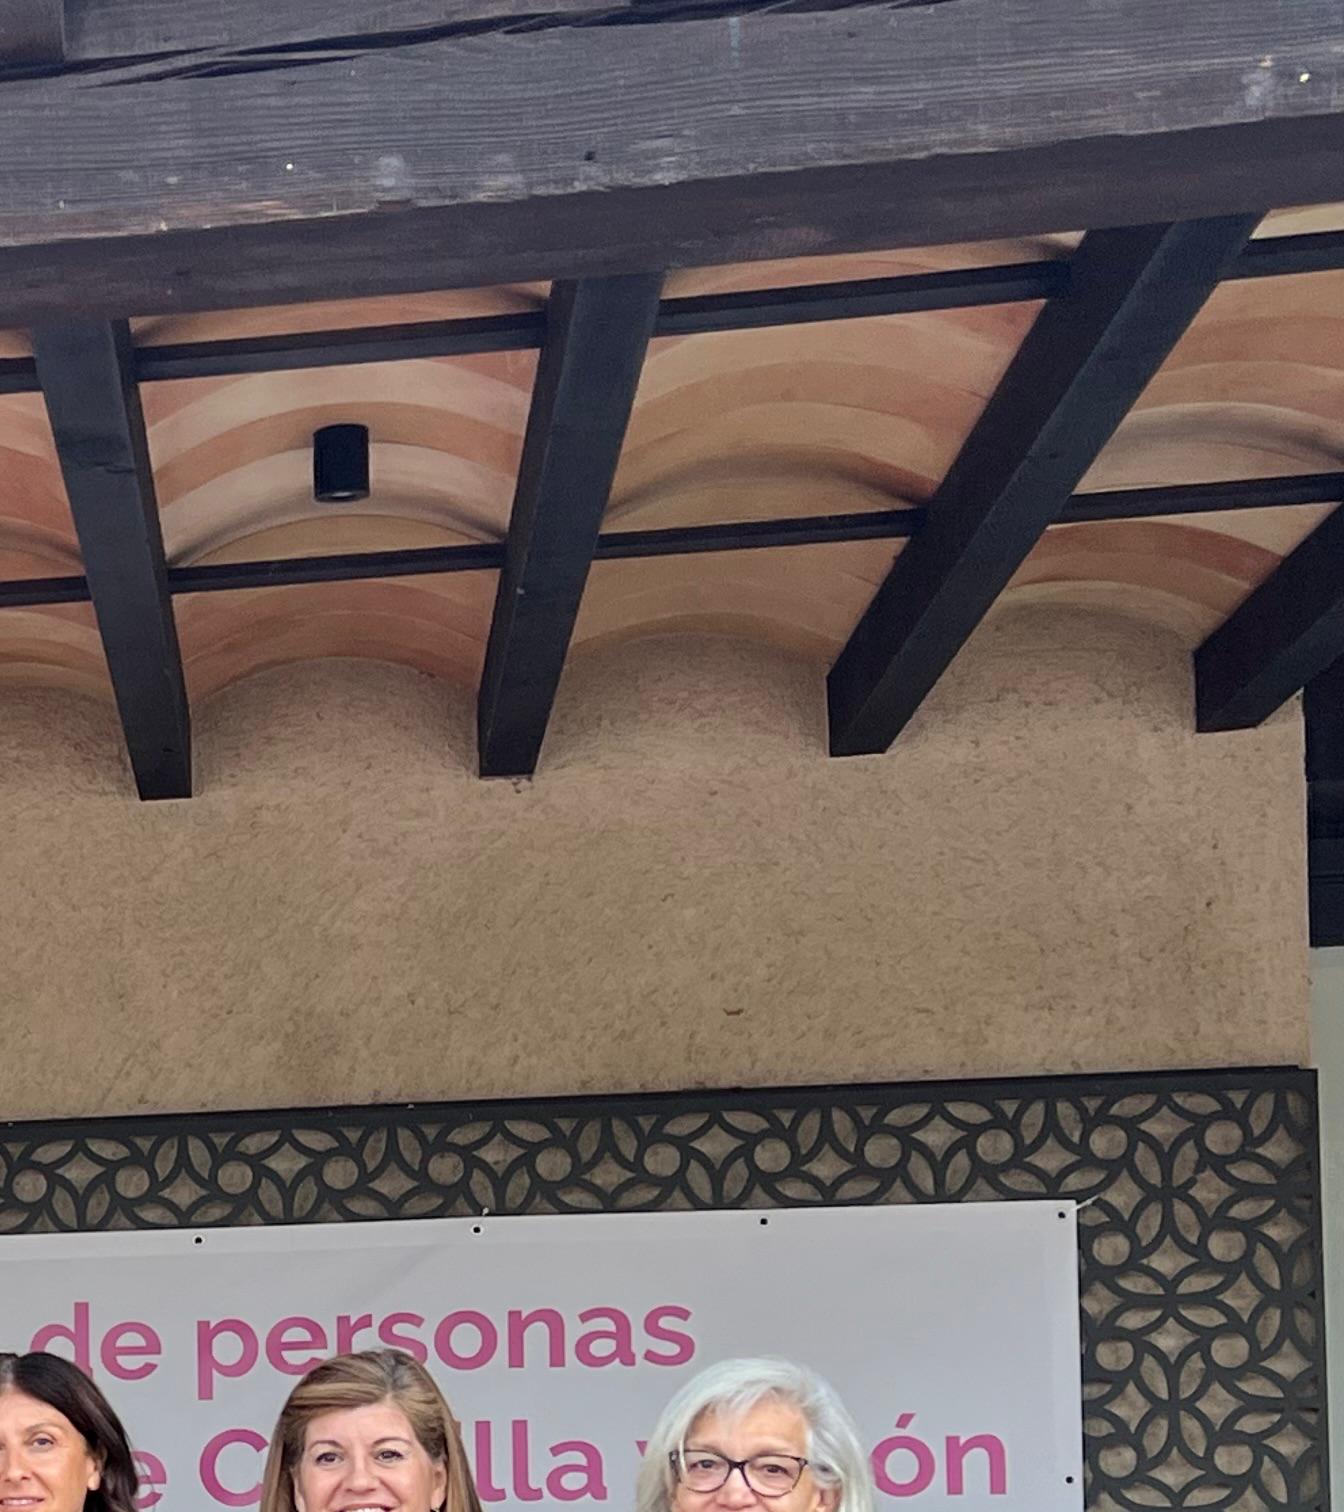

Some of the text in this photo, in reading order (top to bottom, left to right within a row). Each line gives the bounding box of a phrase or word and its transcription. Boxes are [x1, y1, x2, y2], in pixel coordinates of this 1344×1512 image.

[29, 1301, 161, 1382] de
[196, 1305, 696, 1401] personas
[200, 1419, 608, 1507] Clla
